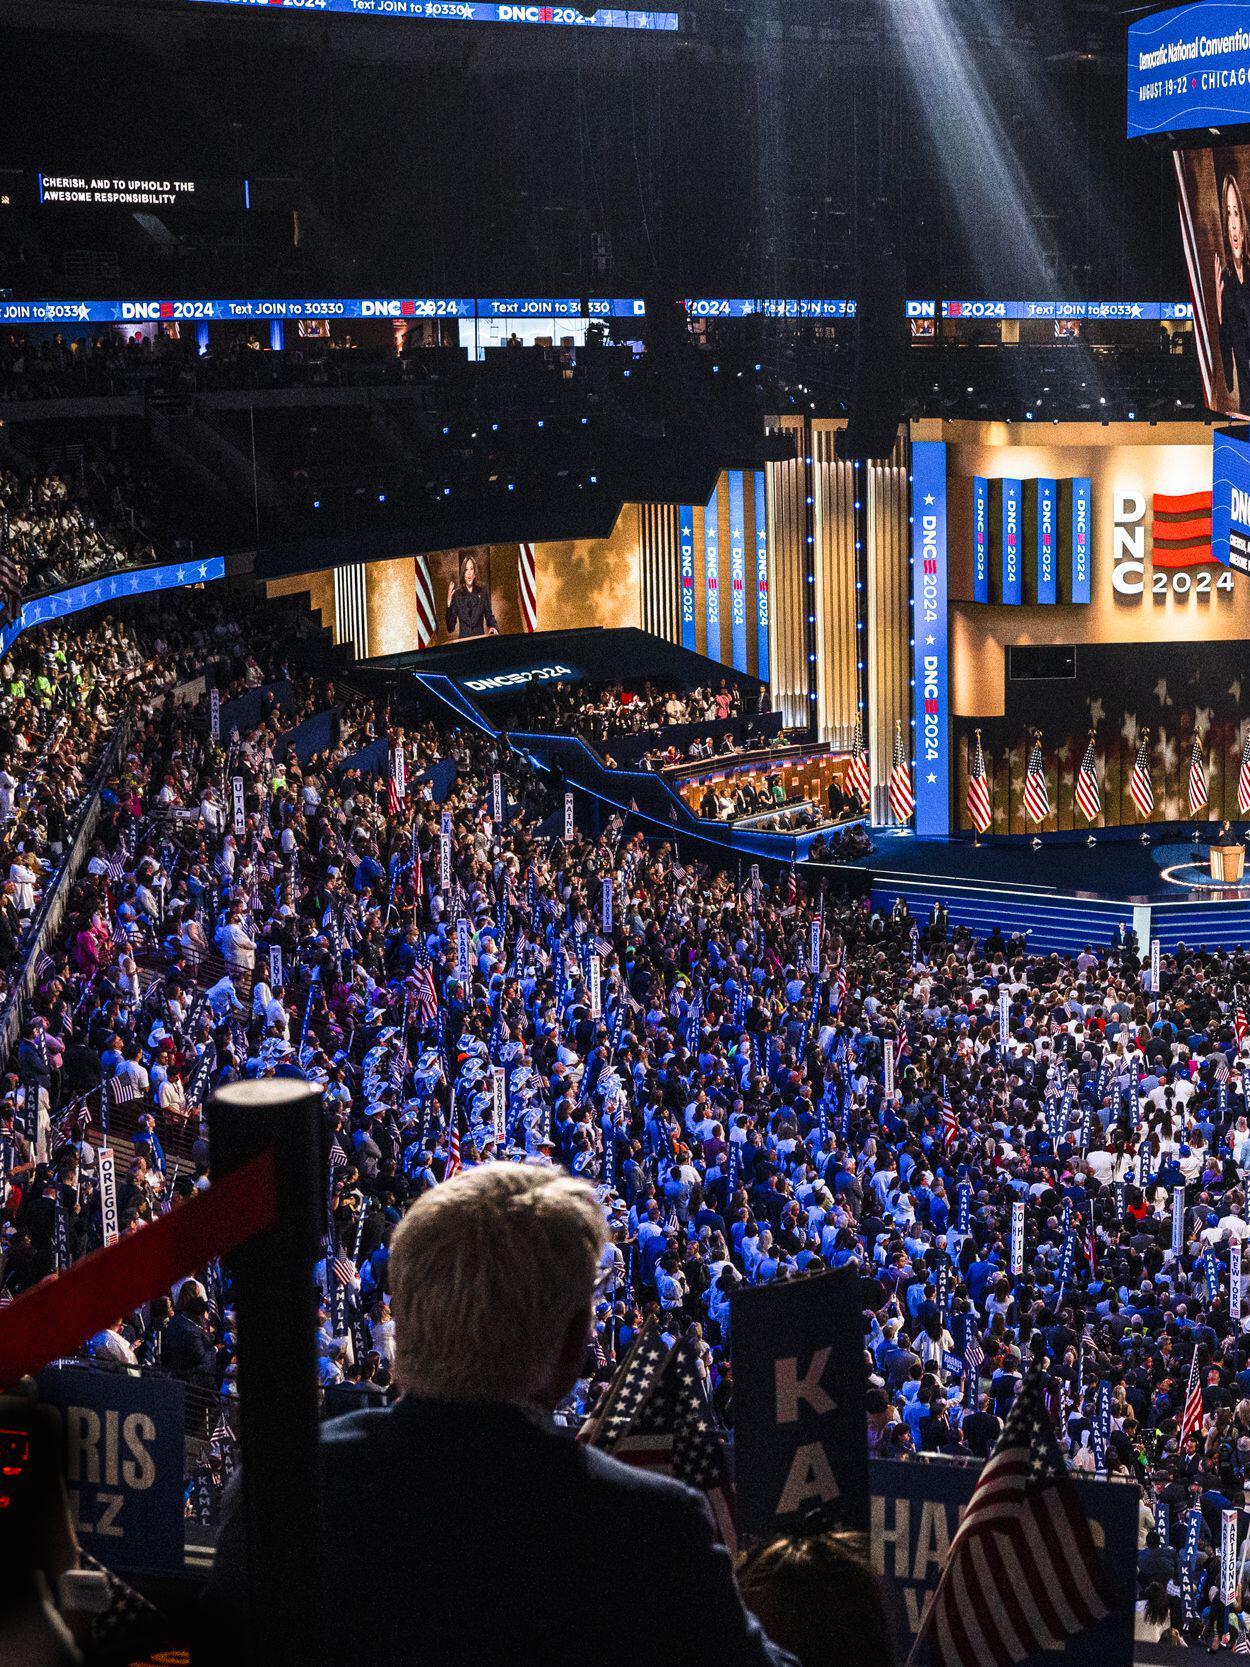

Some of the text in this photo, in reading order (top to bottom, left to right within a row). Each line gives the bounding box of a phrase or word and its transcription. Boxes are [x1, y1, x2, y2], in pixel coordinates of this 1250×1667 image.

[1139, 45, 1168, 71] Democratic
[1168, 35, 1199, 64] National
[1139, 81, 1163, 102] AUGUST
[1165, 78, 1188, 96] 19-22
[42, 177, 195, 192] CHERISH, AND TO UPHOLD THE
[44, 191, 176, 204] AWESOME RESPONSIBILITY
[229, 301, 344, 316] Text JOIN to 30330
[1151, 571, 1234, 593] 2024
[235, 782, 244, 827] UTAH
[459, 926, 467, 974] ALABAMA
[27, 1084, 38, 1138] KAMALA
[101, 1079, 109, 1129] KAMALA
[102, 1160, 116, 1233] OREGON
[939, 1263, 947, 1308] KAMALA
[1206, 1253, 1218, 1298] KAMALA
[1231, 1254, 1239, 1309] NEW YORK
